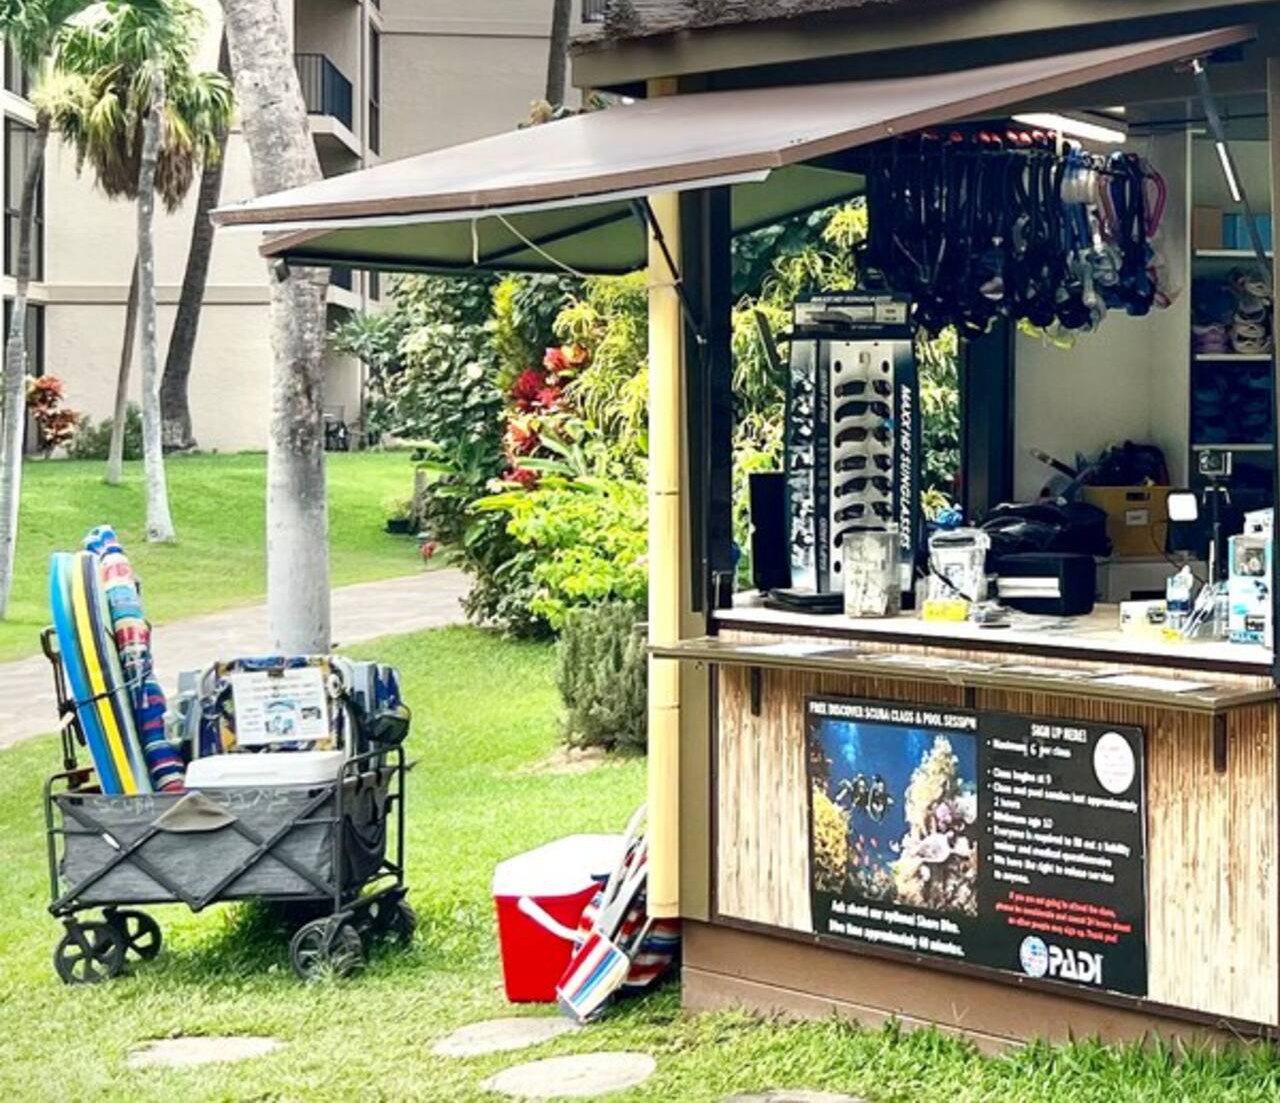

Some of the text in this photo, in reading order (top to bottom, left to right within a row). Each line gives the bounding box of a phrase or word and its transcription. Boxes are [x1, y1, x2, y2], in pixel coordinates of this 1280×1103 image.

[900, 452, 912, 551] SUNGLASSES
[865, 706, 890, 720] SCUBA
[1051, 726, 1062, 739] UP
[1049, 945, 1104, 985] PADI
